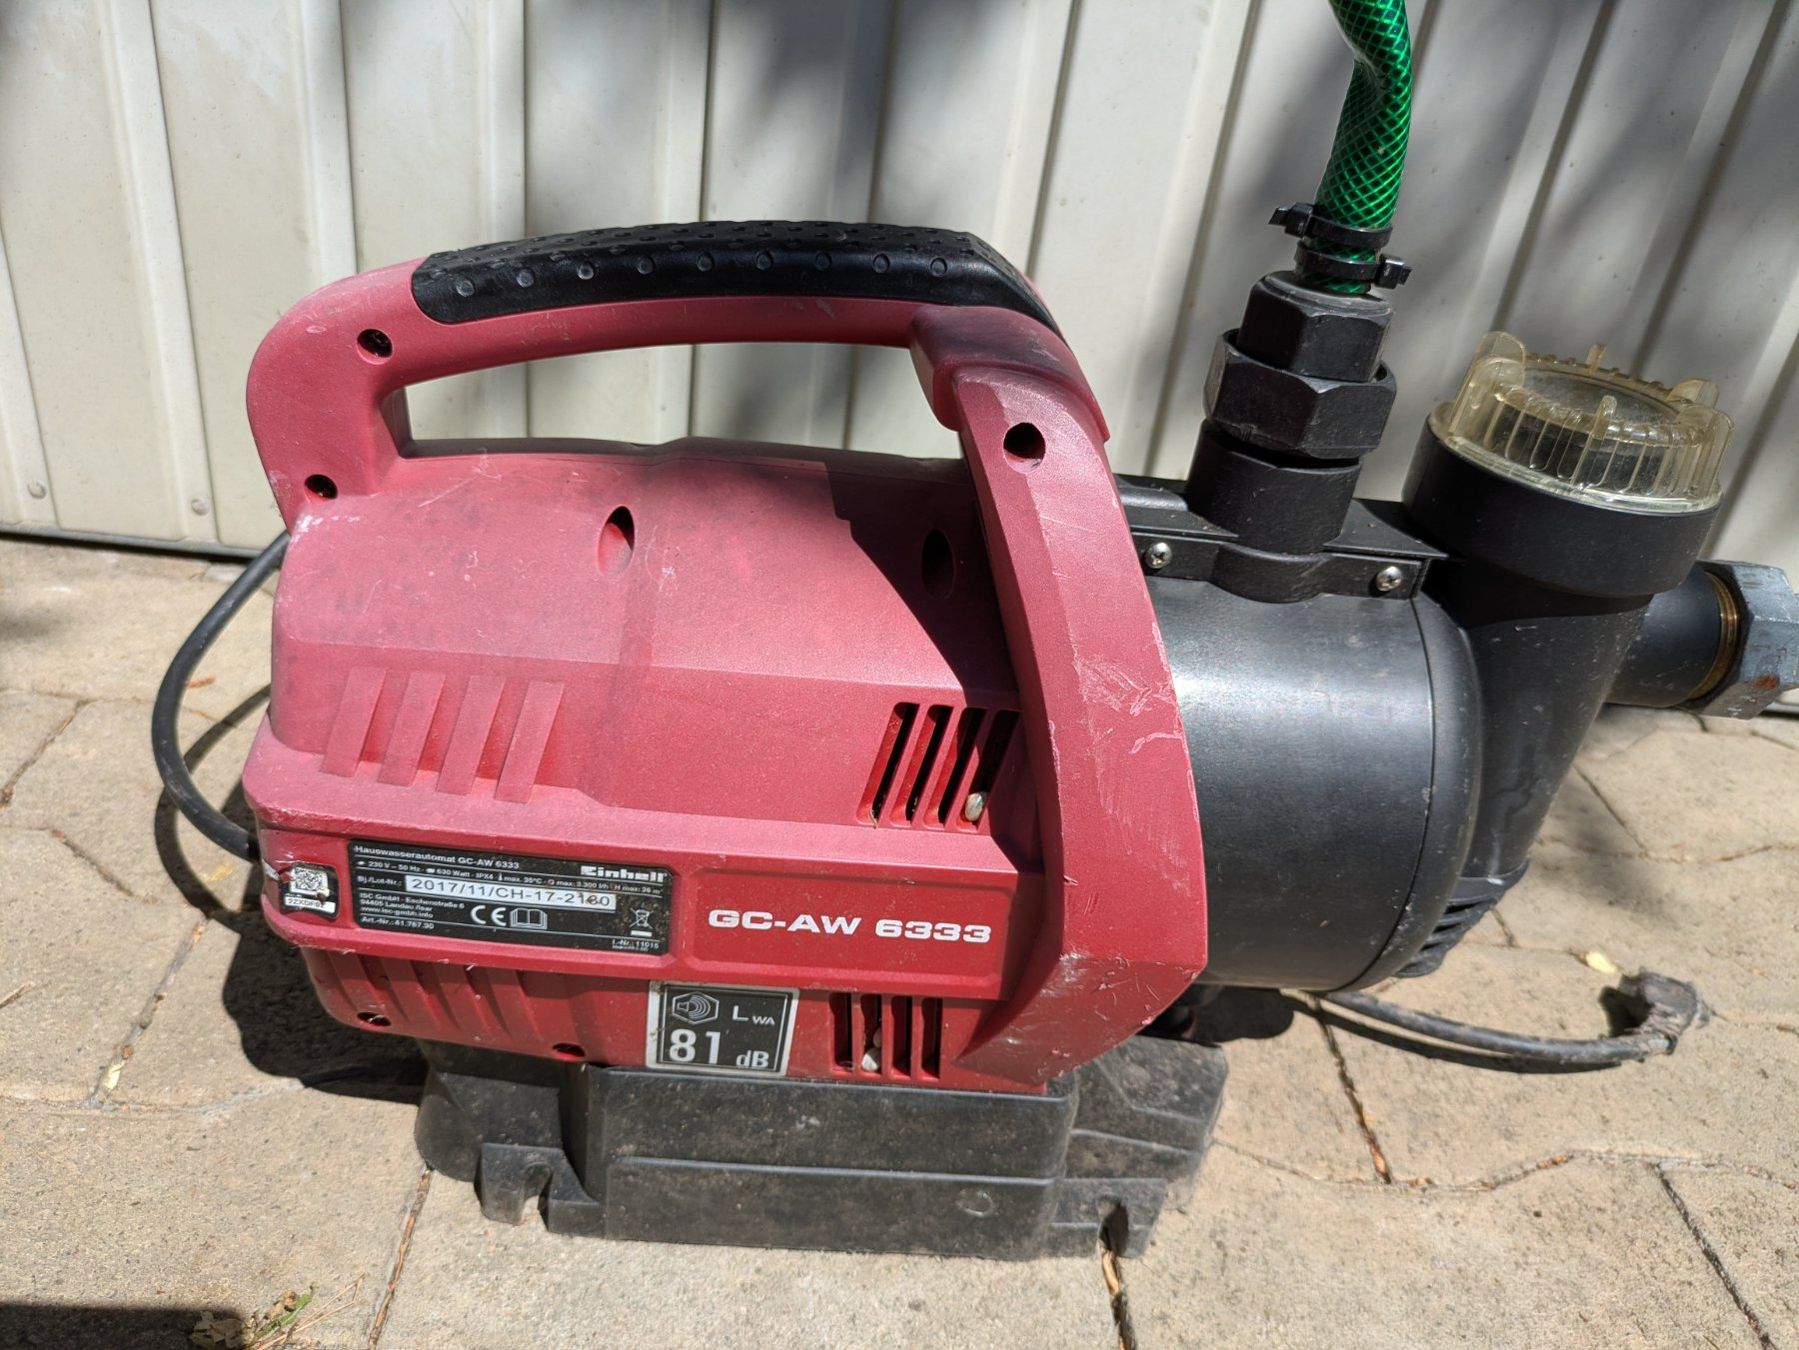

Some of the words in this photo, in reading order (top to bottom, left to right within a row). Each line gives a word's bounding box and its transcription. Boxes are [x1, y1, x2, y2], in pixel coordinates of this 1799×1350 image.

[354, 845, 455, 861] Hauswasserautomat
[458, 857, 493, 866] GC-AW
[495, 860, 520, 869] 6333
[581, 865, 664, 882] Einhell
[707, 908, 863, 936] GC-AW
[874, 918, 992, 944] 6333
[752, 1015, 776, 1025] WA
[669, 1028, 721, 1066] 81
[735, 1049, 770, 1069] dB
